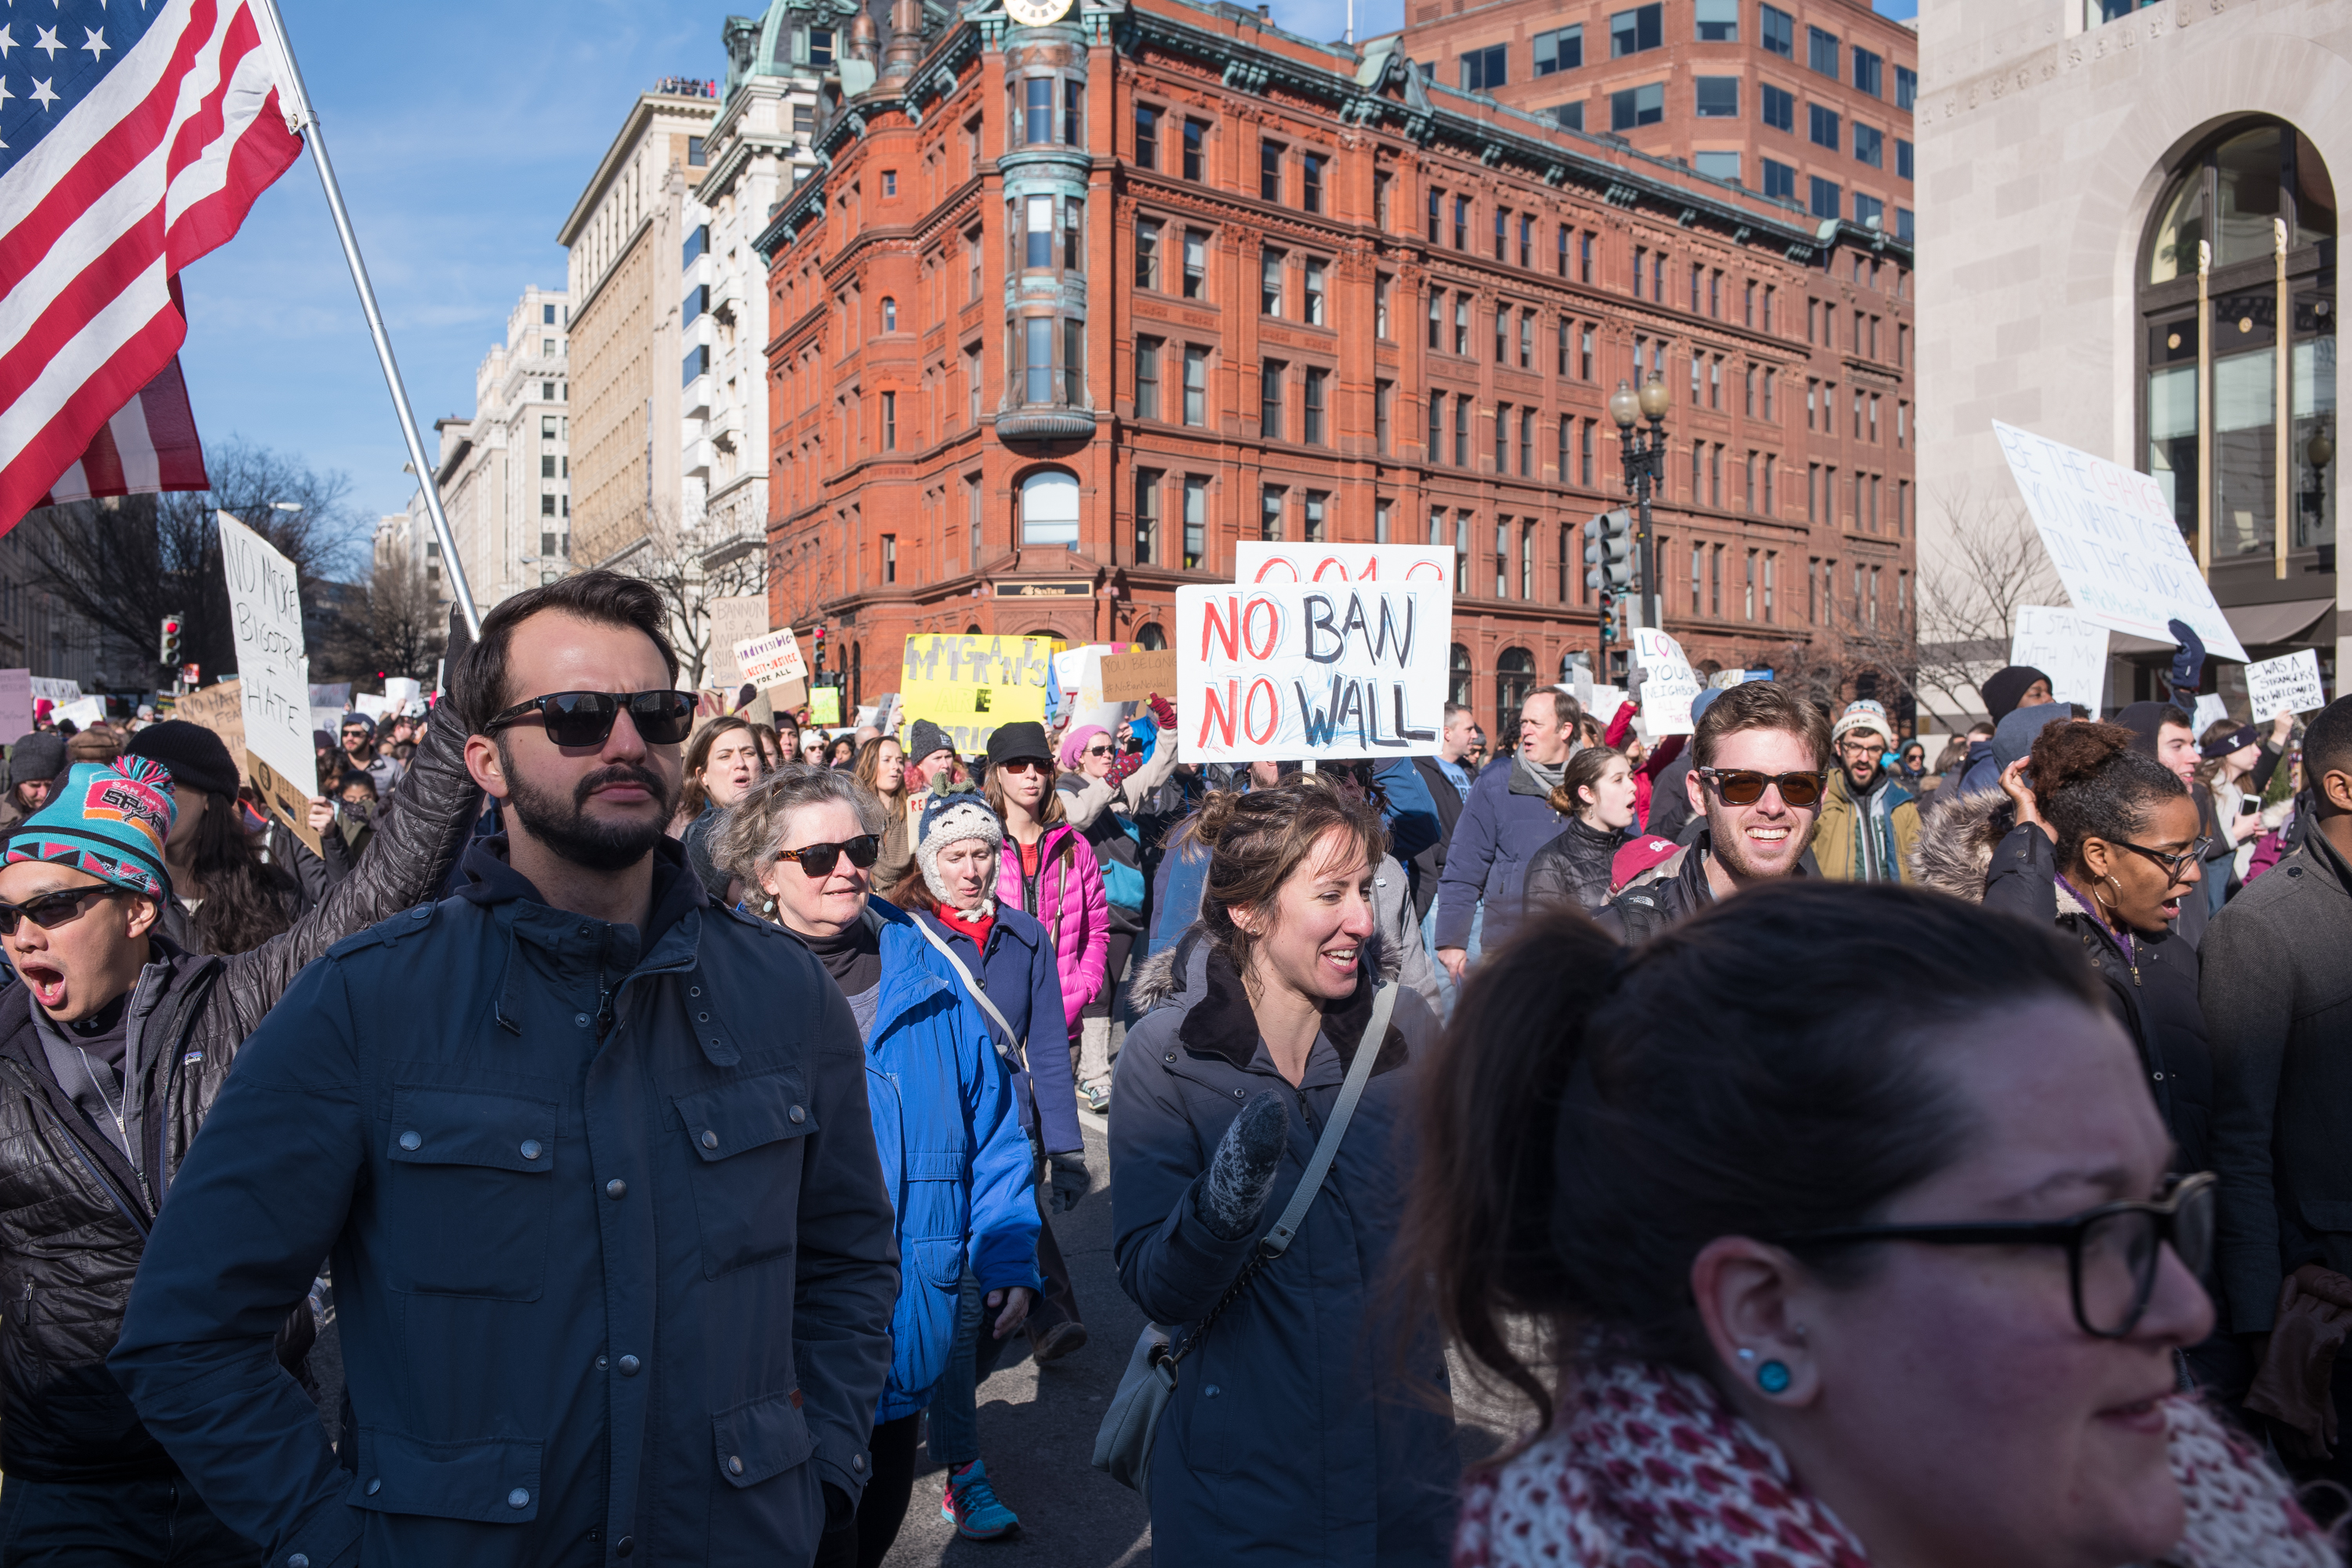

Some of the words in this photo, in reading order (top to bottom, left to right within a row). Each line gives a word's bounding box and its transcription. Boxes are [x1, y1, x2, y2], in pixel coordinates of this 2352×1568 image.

[1996, 426, 2041, 475] BE
[2037, 440, 2094, 493] THE
[2090, 461, 2176, 524] CHANGE
[2016, 474, 2072, 528] YOU
[2064, 491, 2129, 542] WANT
[2125, 513, 2157, 552] TO
[2042, 527, 2089, 574] IN
[223, 527, 255, 593] NO
[262, 554, 298, 625] MORE
[717, 601, 765, 620] BANNON
[725, 620, 735, 630] IS
[744, 619, 753, 632] A
[1201, 591, 1280, 664] NO
[1303, 590, 1414, 670] BAN
[2021, 611, 2034, 635] I
[236, 602, 301, 679] BIGOTRY
[770, 652, 797, 670] JUSTICE
[2017, 641, 2057, 666] WITH
[757, 675, 772, 684] FOR
[775, 668, 791, 678] ALL
[1104, 659, 1126, 673] YOU
[1650, 665, 1693, 682] YOUR
[2261, 659, 2287, 675] WAS
[181, 697, 202, 720] NO
[246, 677, 299, 737] HATE
[935, 688, 992, 713] ARE
[2252, 693, 2270, 706] YOU
[1197, 675, 1280, 749] NO
[1294, 672, 1436, 752] WALL
[2228, 735, 2240, 747] Y
[111, 781, 138, 795] SAN
